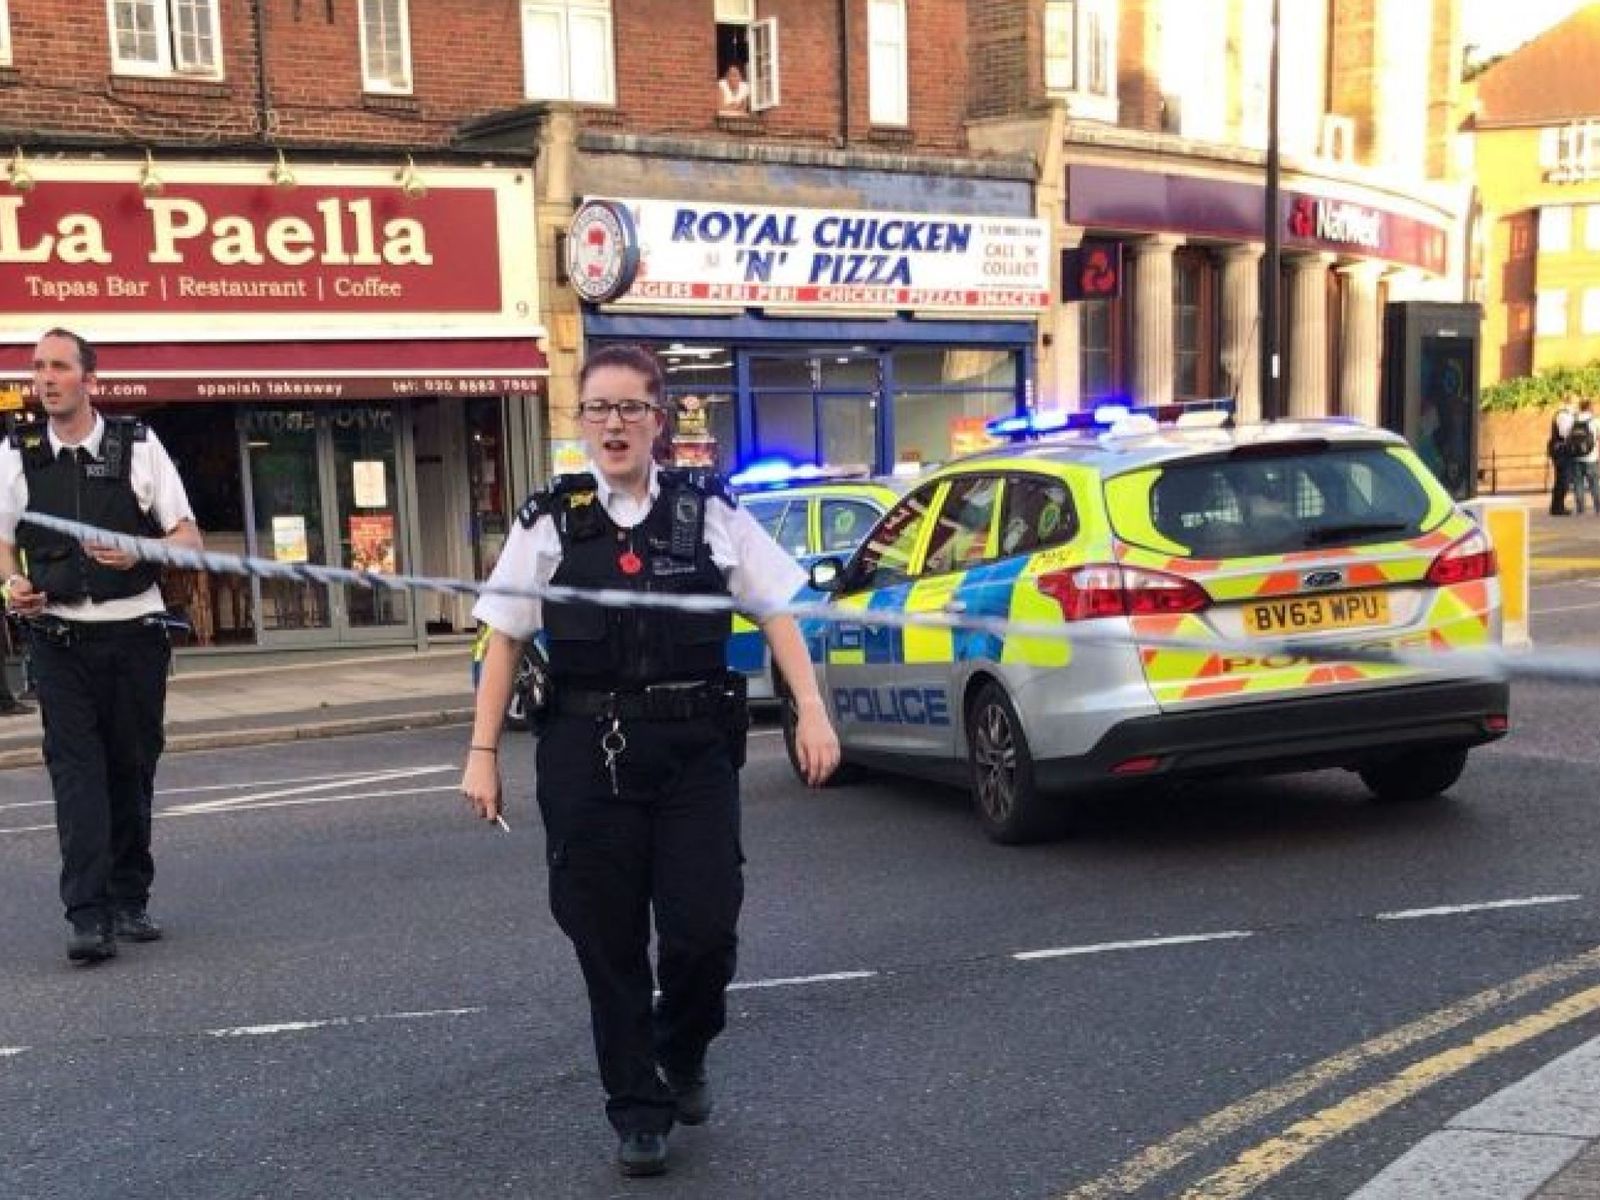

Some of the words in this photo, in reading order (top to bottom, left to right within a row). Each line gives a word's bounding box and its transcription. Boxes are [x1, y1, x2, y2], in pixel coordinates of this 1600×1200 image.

[0, 195, 113, 263] La
[143, 196, 434, 266] Paella
[670, 208, 799, 246] ROYAL
[812, 215, 972, 253] CHICKEN
[735, 249, 789, 283] 'N'
[807, 251, 912, 286] PIZZA
[25, 275, 100, 302] Tapas
[106, 275, 150, 297] Bar
[178, 276, 308, 298] Restaurant
[334, 276, 403, 298] Coffee
[516, 299, 530, 319] 9
[197, 381, 261, 397] spanish
[266, 381, 343, 397] takeaway
[1253, 600, 1324, 631] BV63
[1330, 595, 1379, 622] WPU
[832, 686, 951, 725] POLICE
